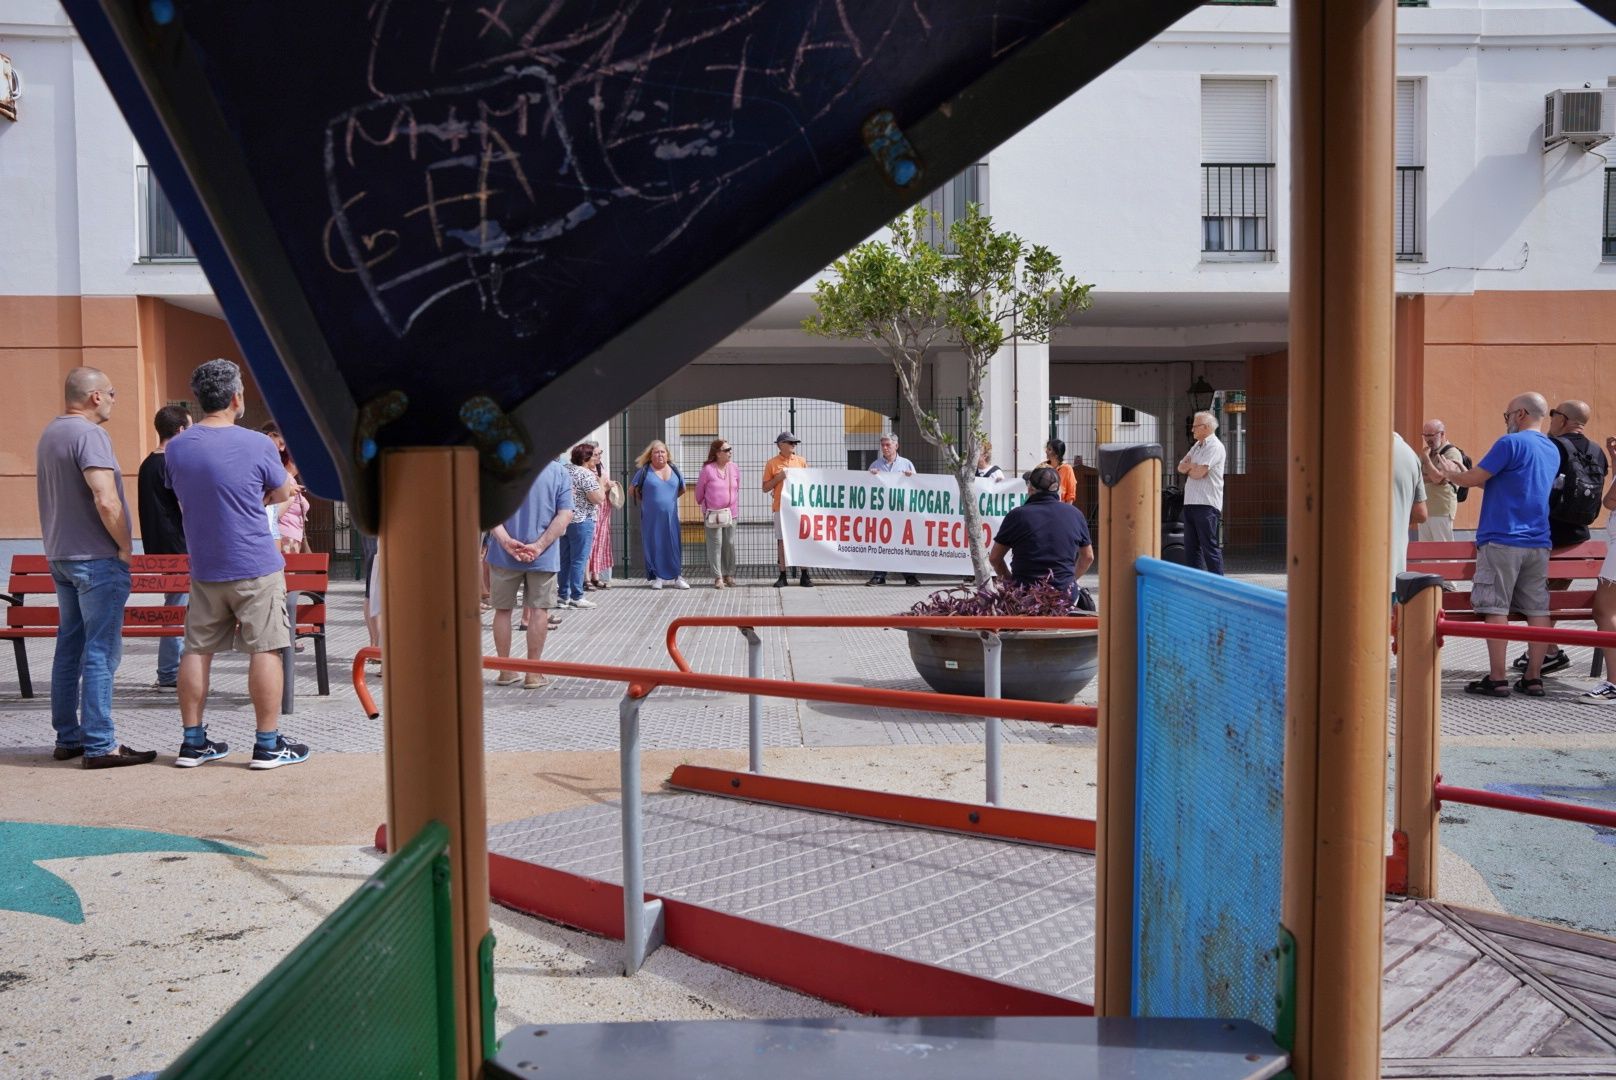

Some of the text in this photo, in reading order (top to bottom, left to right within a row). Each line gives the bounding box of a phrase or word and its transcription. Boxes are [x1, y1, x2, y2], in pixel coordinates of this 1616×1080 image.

[791, 484, 805, 507] LA
[809, 484, 845, 509] CALLE
[849, 486, 866, 510] NO
[870, 487, 885, 511] ES
[889, 488, 905, 512] UN
[909, 489, 955, 515] HOGAR.
[979, 492, 1016, 517] CALLE
[798, 514, 893, 545] DERECHO
[902, 519, 915, 545] A
[868, 545, 878, 554] Pro
[878, 545, 904, 556] Derechos
[904, 547, 930, 557] Humanos
[931, 549, 938, 558] de
